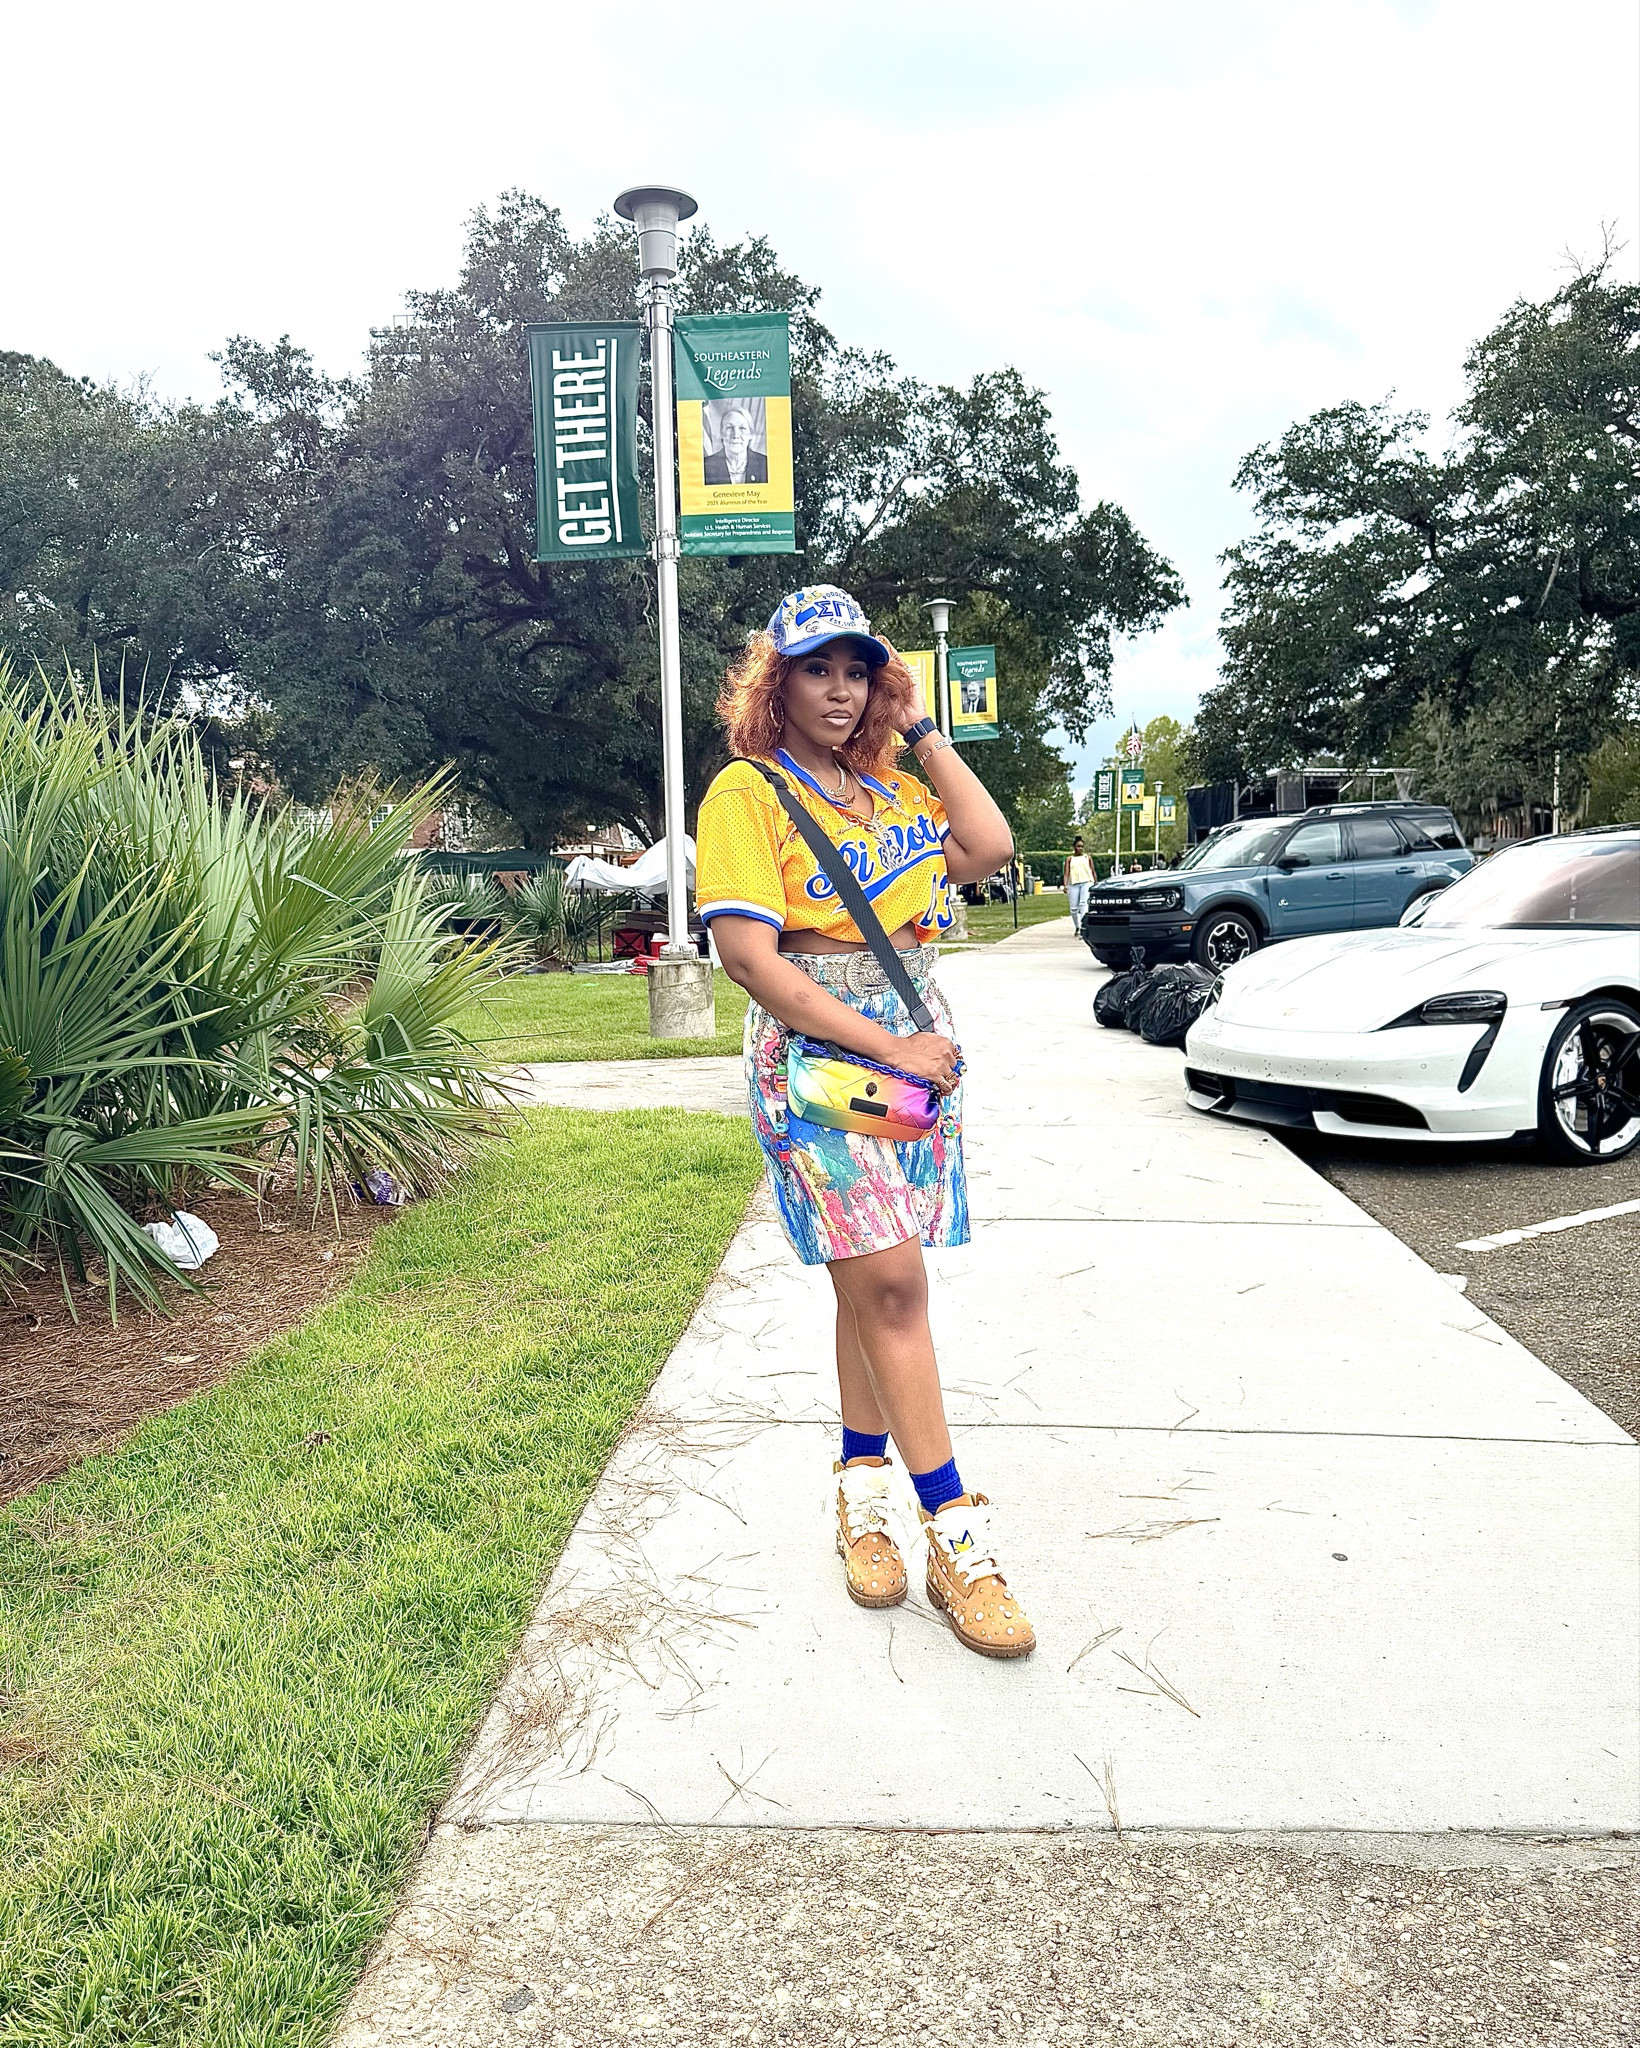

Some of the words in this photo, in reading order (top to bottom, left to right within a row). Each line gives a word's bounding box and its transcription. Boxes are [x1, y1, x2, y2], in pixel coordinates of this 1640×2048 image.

[694, 350, 770, 363] SOUTHEASTERN
[704, 361, 762, 391] Legends
[552, 339, 607, 469] THERE.
[746, 490, 760, 499] May
[558, 475, 611, 546] GET
